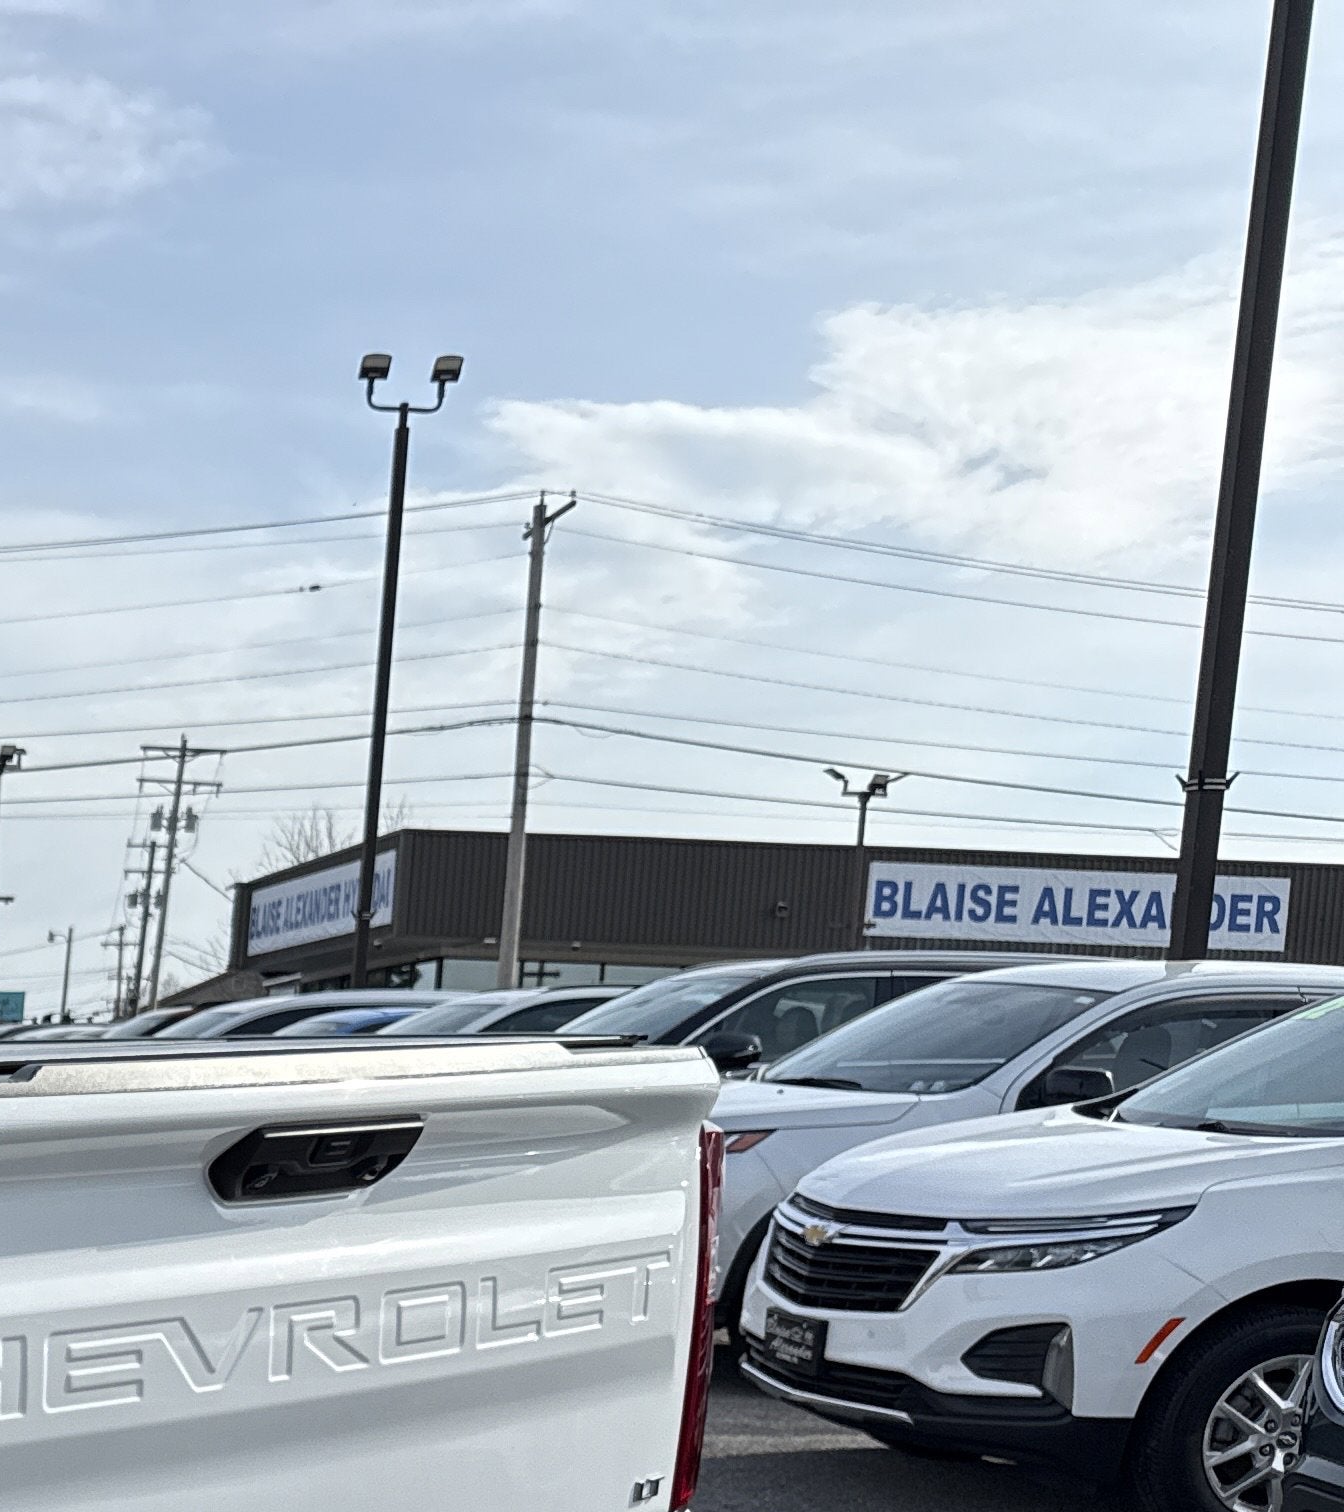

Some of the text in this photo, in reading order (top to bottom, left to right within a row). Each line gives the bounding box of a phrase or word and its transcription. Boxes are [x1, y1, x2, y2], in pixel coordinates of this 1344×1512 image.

[250, 868, 392, 940] BLAISE ALEXANDER HYDAI
[872, 880, 1282, 935] BLAISE ALEXADER
